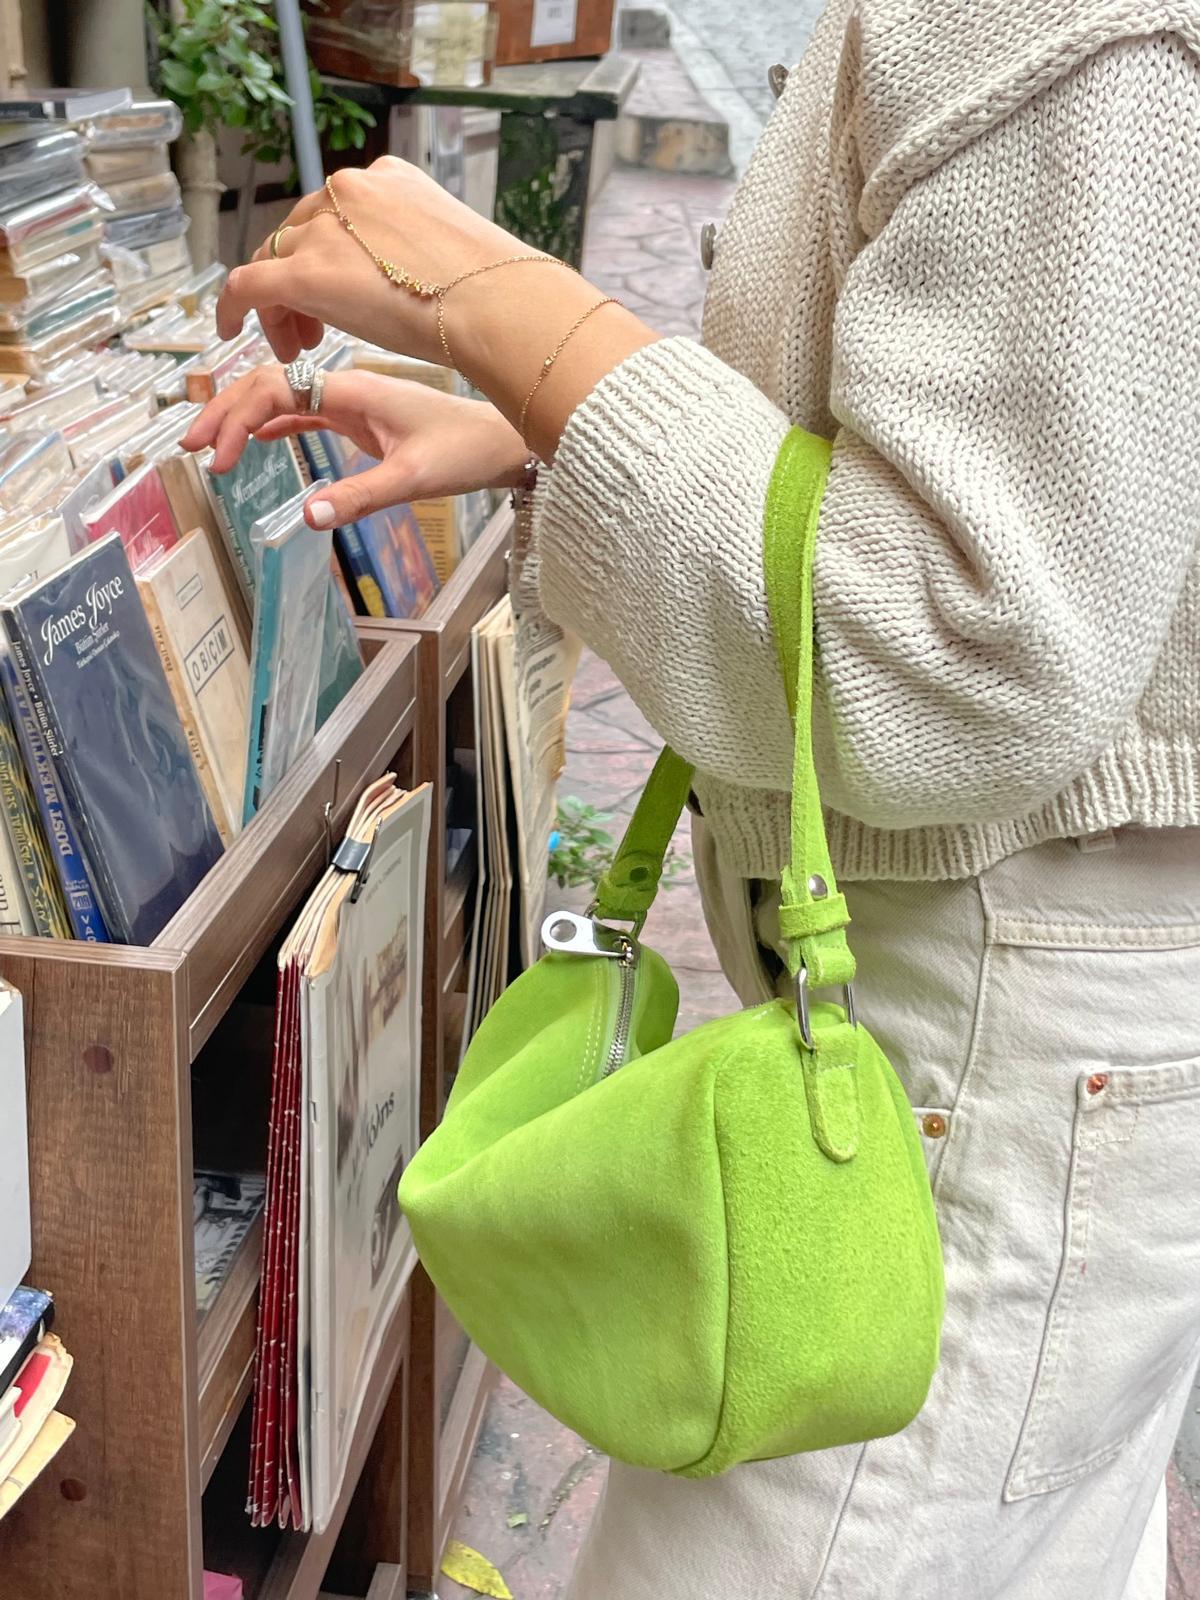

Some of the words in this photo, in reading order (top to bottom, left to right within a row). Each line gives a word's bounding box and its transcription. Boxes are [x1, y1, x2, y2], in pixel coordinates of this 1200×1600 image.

[41, 604, 86, 666] James
[86, 576, 124, 631] Joyce
[192, 661, 201, 681] O
[199, 628, 228, 672] BİÇİM
[12, 641, 27, 668] James
[21, 669, 36, 692] Joyce
[34, 701, 49, 729] Bütün
[43, 729, 60, 757] Şiirler
[49, 809, 73, 857] DOST
